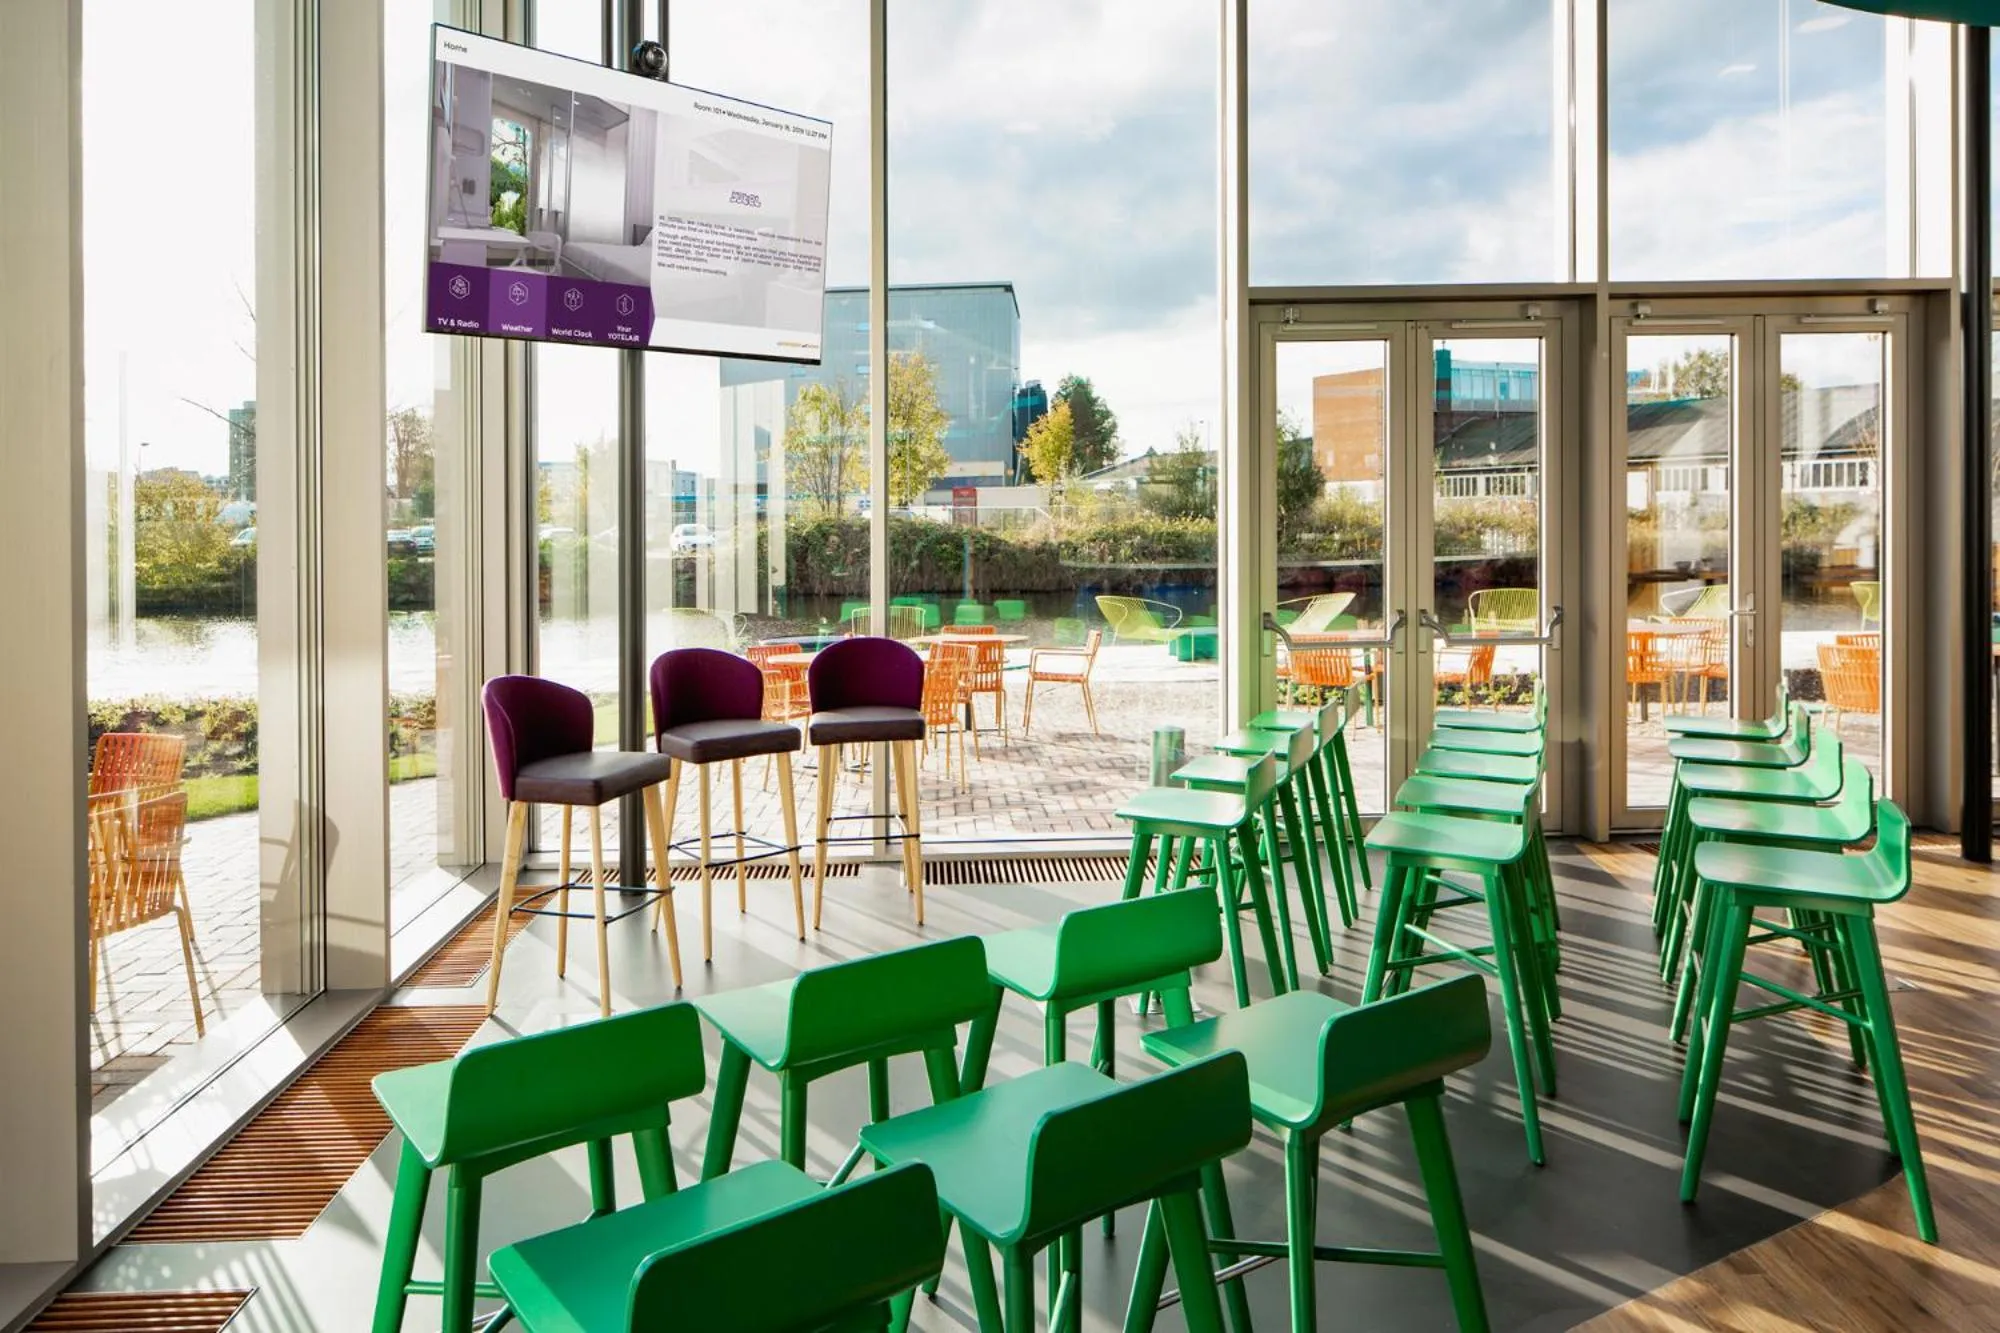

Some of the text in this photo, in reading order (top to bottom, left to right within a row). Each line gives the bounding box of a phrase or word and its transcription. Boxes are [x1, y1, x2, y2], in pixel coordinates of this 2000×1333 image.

[443, 41, 468, 53] Home
[437, 317, 480, 329] TV & Radio
[501, 323, 533, 333] Weather
[551, 326, 593, 338] World Clock
